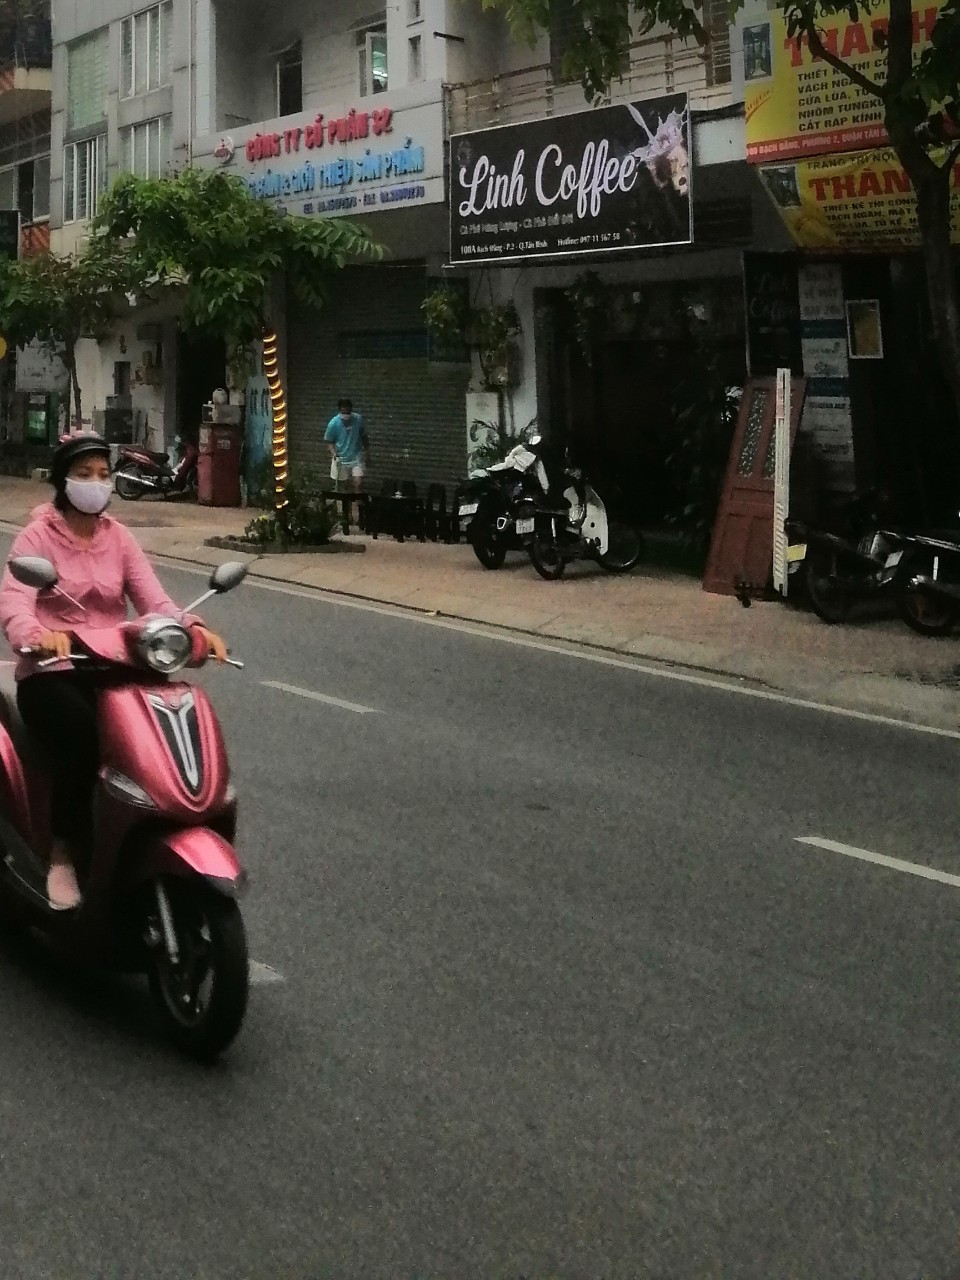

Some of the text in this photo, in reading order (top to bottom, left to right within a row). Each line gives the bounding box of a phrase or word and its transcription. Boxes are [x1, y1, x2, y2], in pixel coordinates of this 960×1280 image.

[284, 127, 302, 154] TY
[458, 138, 639, 218] Linh Coffee
[808, 167, 912, 202] THÀN
